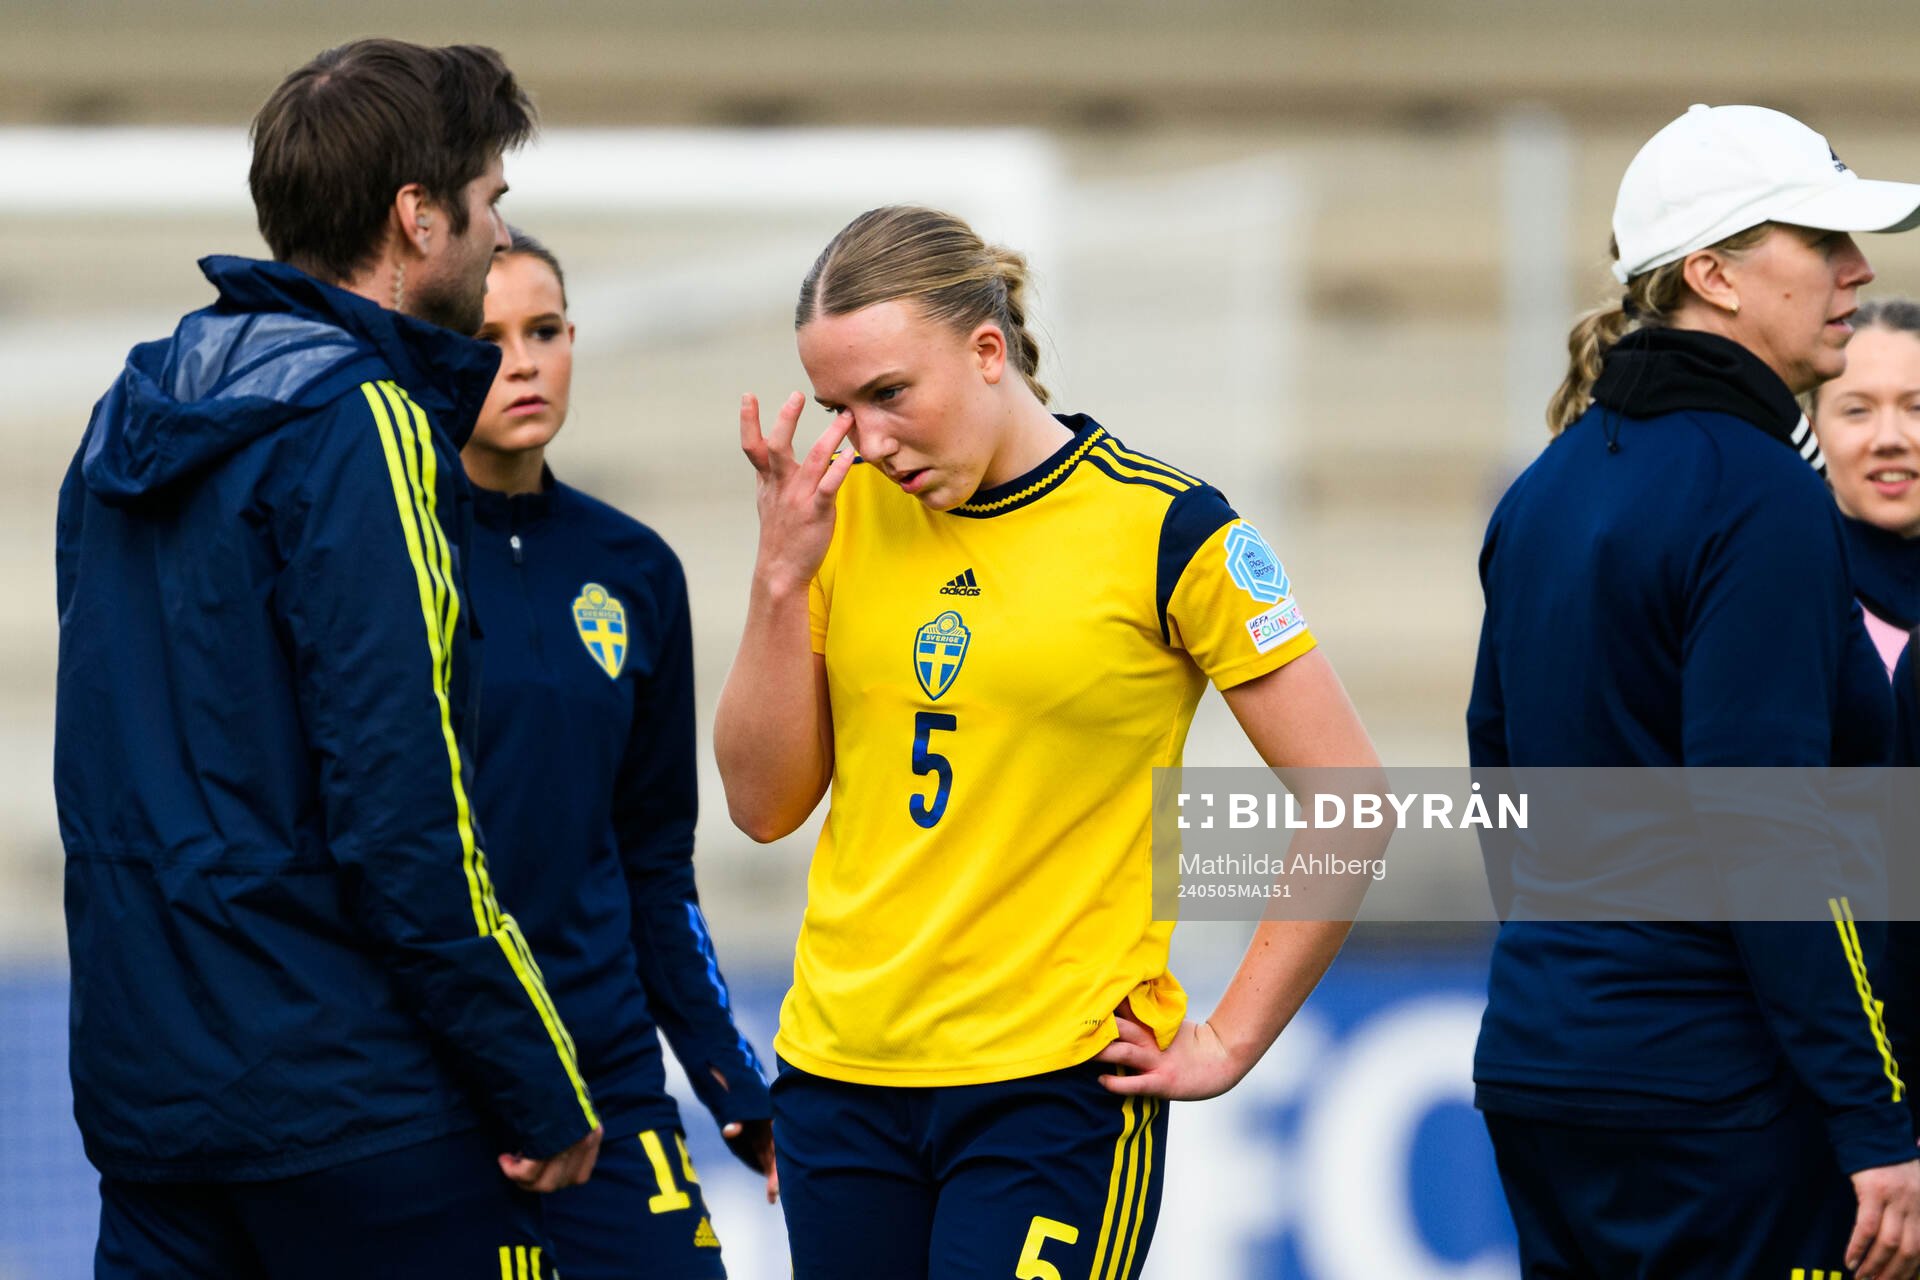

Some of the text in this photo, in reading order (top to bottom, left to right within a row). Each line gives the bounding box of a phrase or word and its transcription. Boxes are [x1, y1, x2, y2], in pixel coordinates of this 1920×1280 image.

[940, 586, 981, 597] adidas
[1250, 615, 1268, 630] UEFA
[925, 633, 960, 643] SVERIGE
[909, 711, 957, 829] 5
[1015, 1215, 1079, 1280] 5
